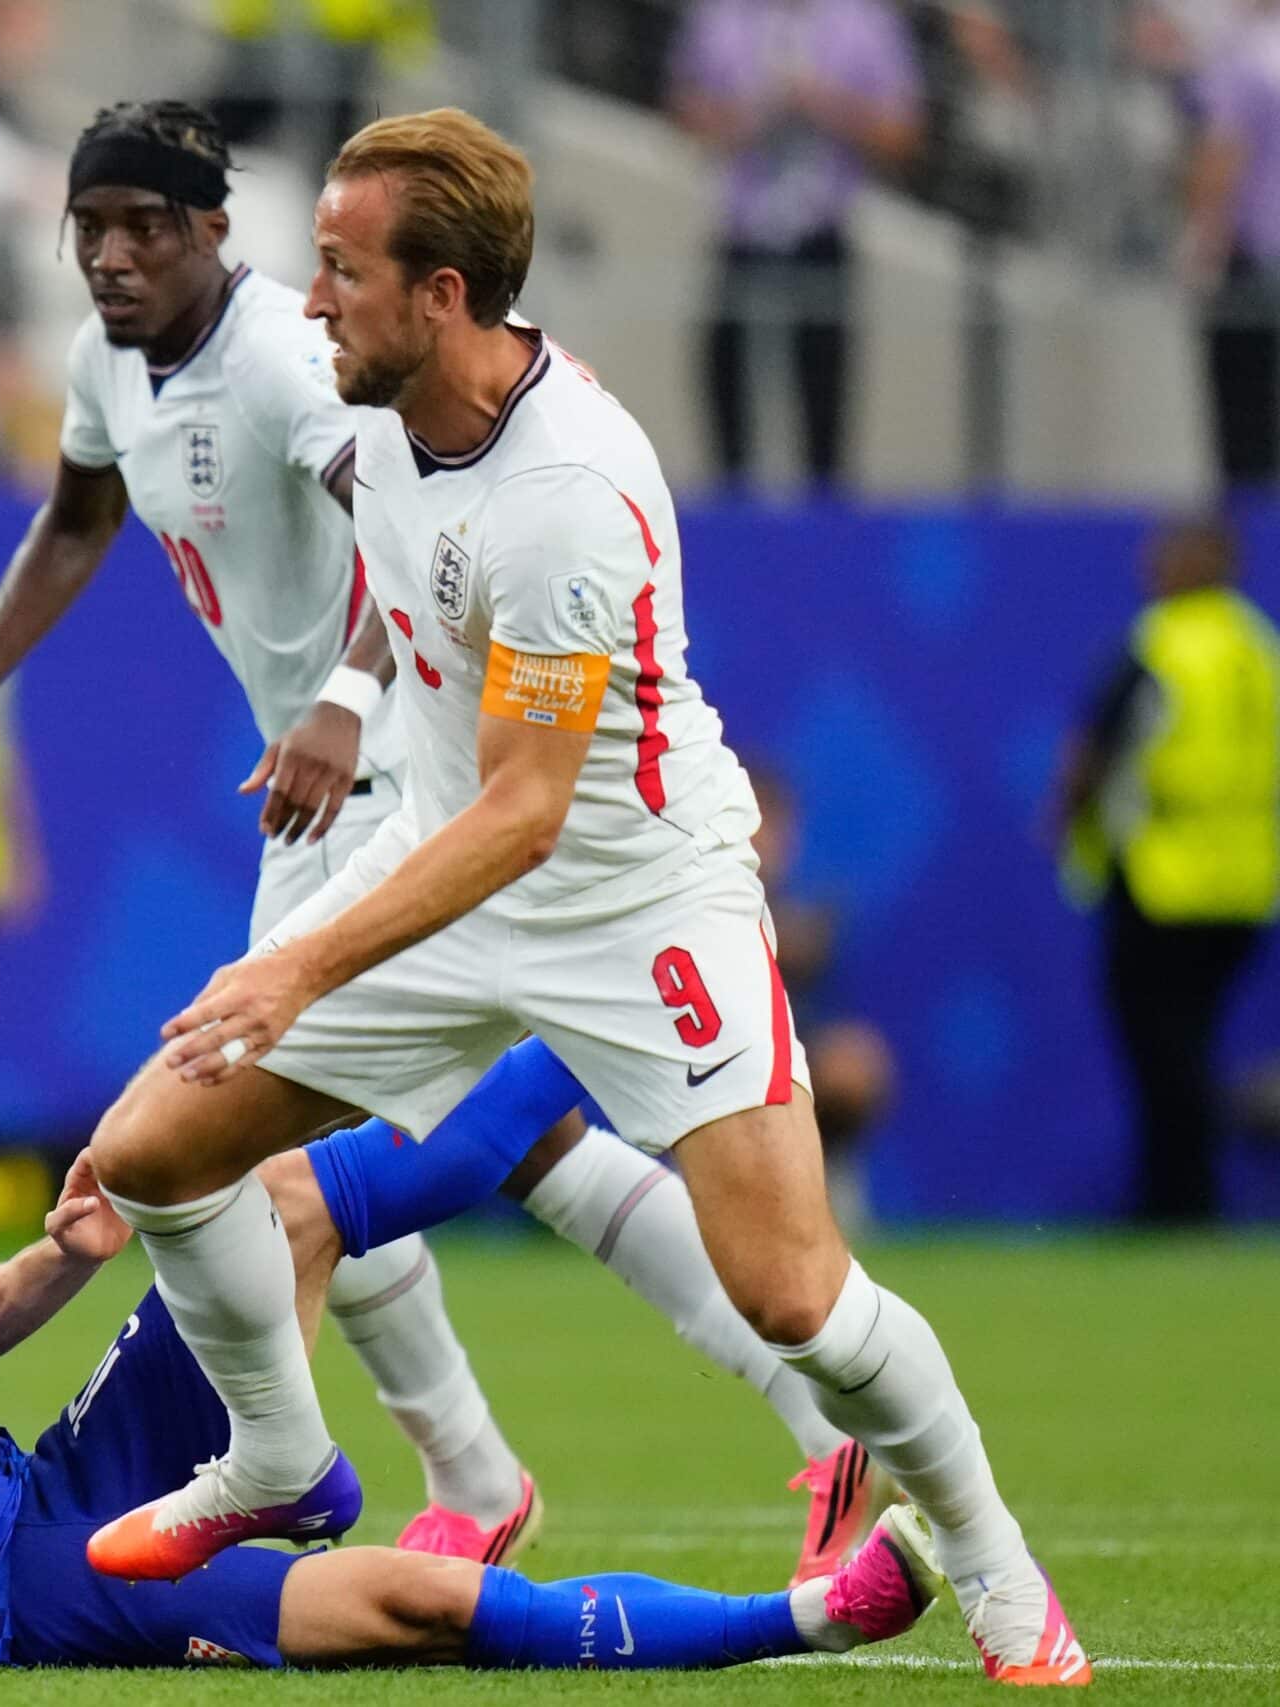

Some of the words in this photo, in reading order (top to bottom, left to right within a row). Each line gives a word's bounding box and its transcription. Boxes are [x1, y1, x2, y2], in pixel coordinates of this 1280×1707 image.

[513, 652, 584, 676] FOOTBALL
[510, 668, 585, 696] UNITES
[527, 711, 553, 723] FIFA
[651, 945, 723, 1049] 9
